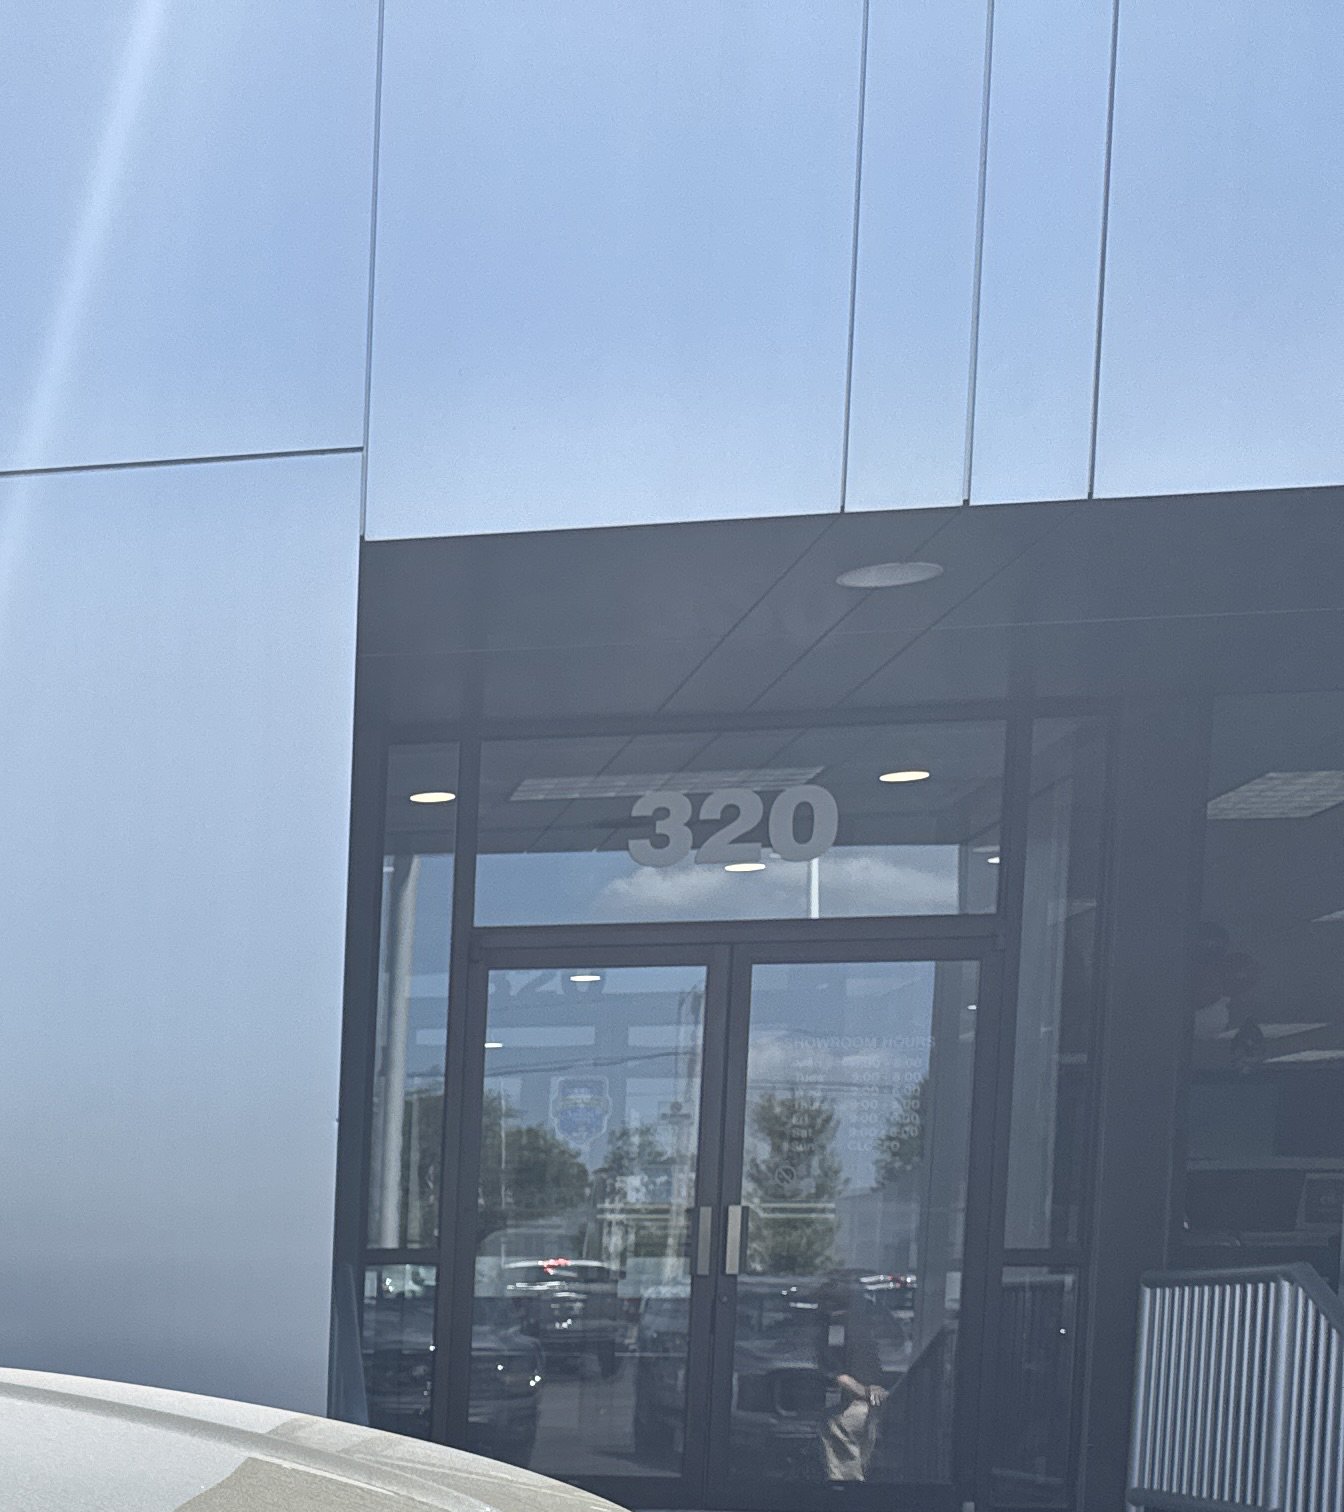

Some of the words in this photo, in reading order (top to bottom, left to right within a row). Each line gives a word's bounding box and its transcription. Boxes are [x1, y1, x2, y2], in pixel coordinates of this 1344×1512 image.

[628, 784, 839, 867] 320
[784, 1036, 877, 1048] SHOWROOM
[882, 1035, 936, 1048] HOURS
